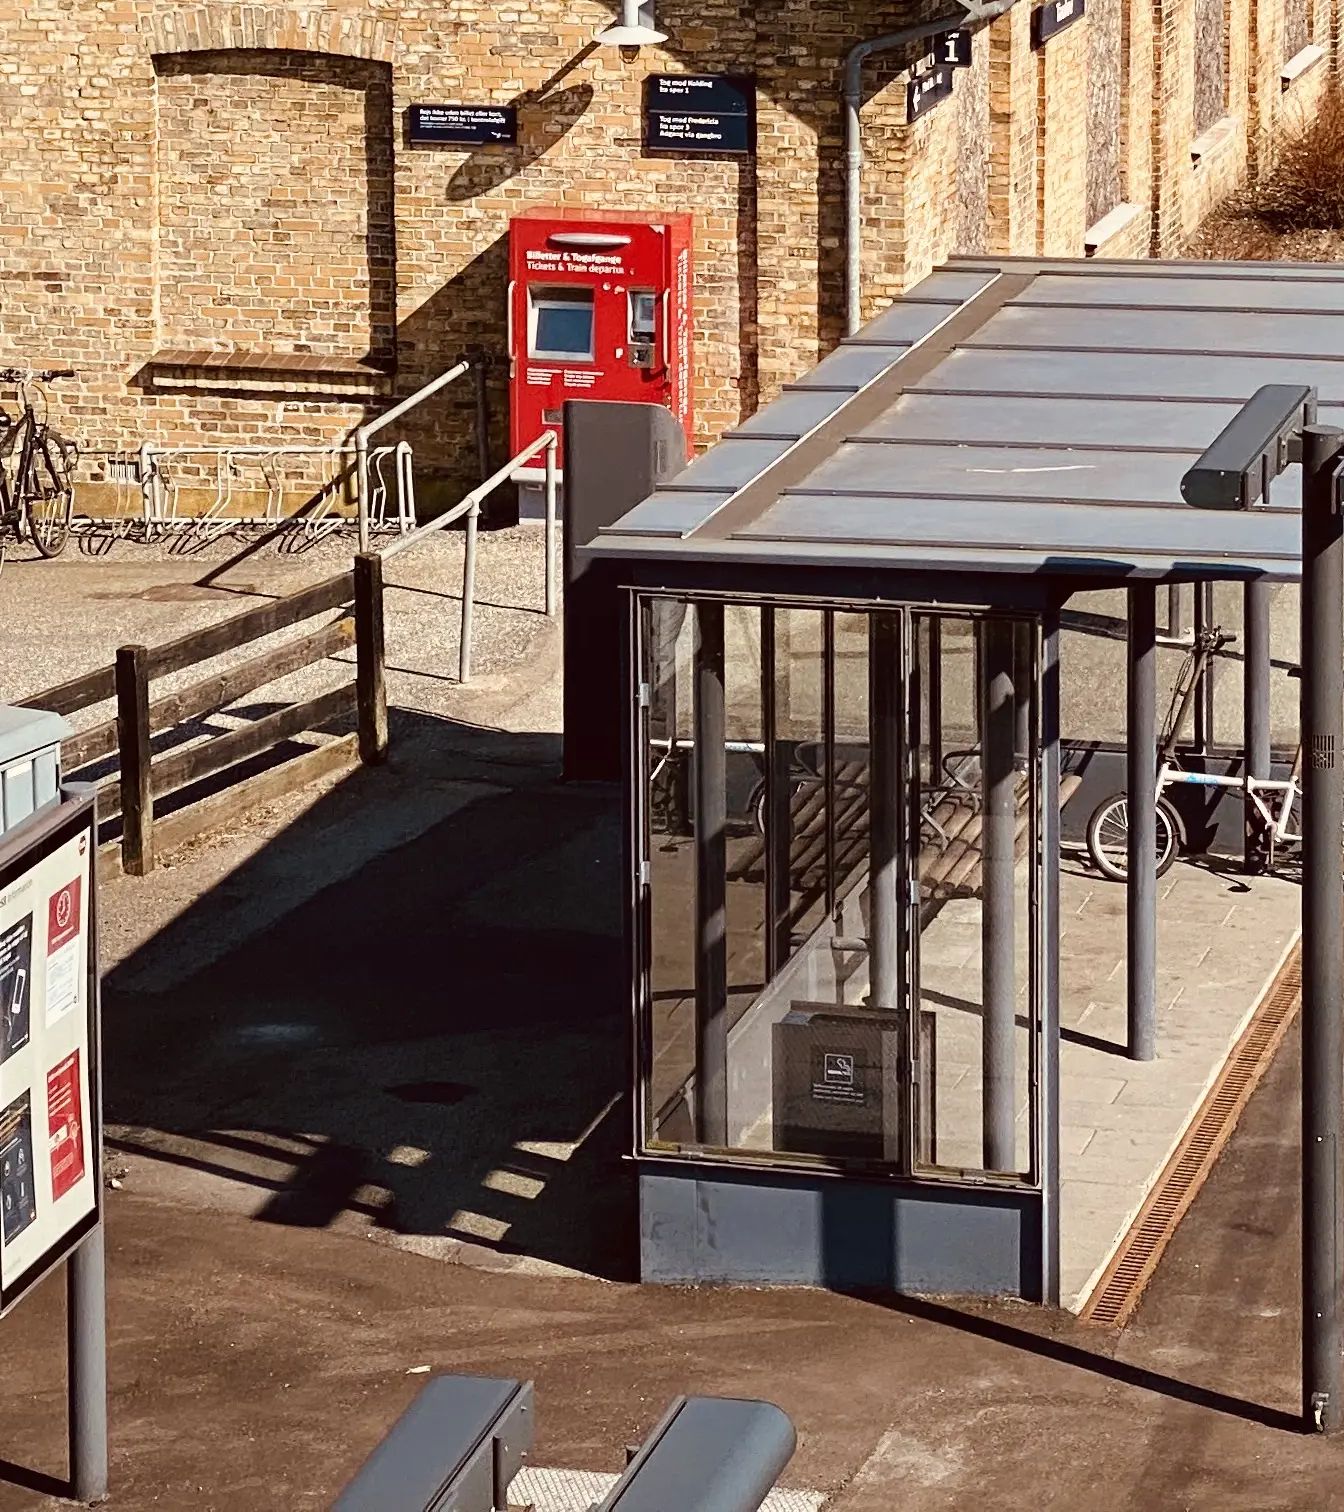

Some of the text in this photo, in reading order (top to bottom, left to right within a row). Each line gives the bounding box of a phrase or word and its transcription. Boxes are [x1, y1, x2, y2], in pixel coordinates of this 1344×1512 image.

[944, 40, 959, 62] 1
[526, 250, 622, 265] Billetter & Togafgange
[526, 261, 556, 271] Tickets
[558, 262, 565, 272] &
[566, 263, 587, 273] Train
